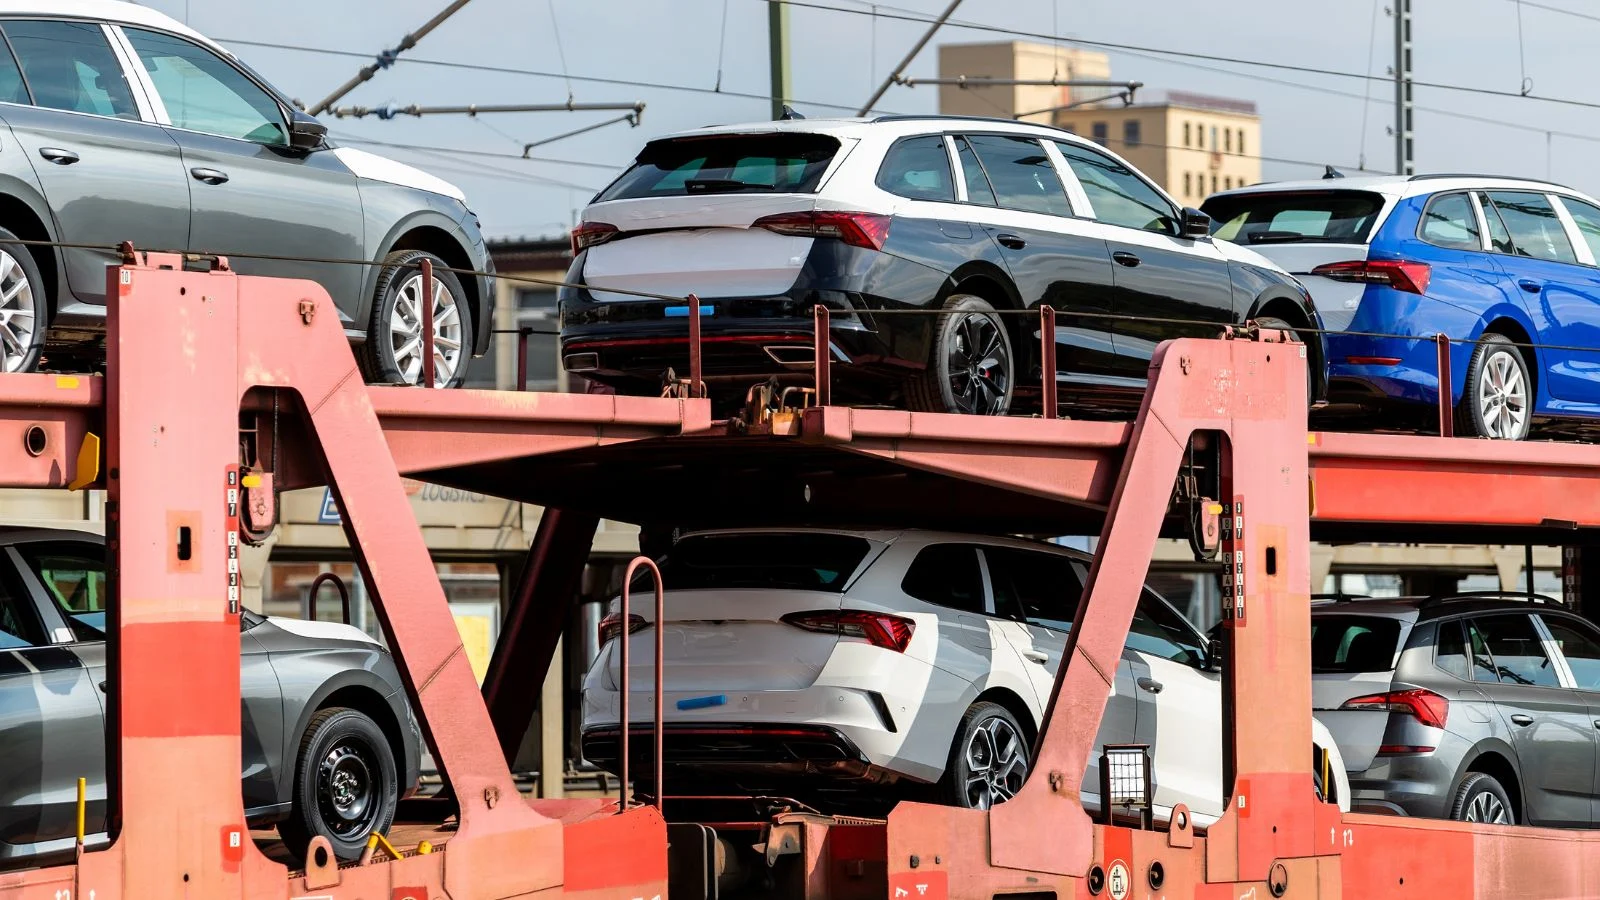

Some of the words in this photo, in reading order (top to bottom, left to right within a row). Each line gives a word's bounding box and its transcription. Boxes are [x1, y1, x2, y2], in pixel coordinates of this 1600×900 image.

[121, 271, 128, 282] 10
[229, 472, 236, 484] 9
[229, 503, 236, 516] 7
[230, 546, 236, 558] 5
[230, 573, 237, 586] 3
